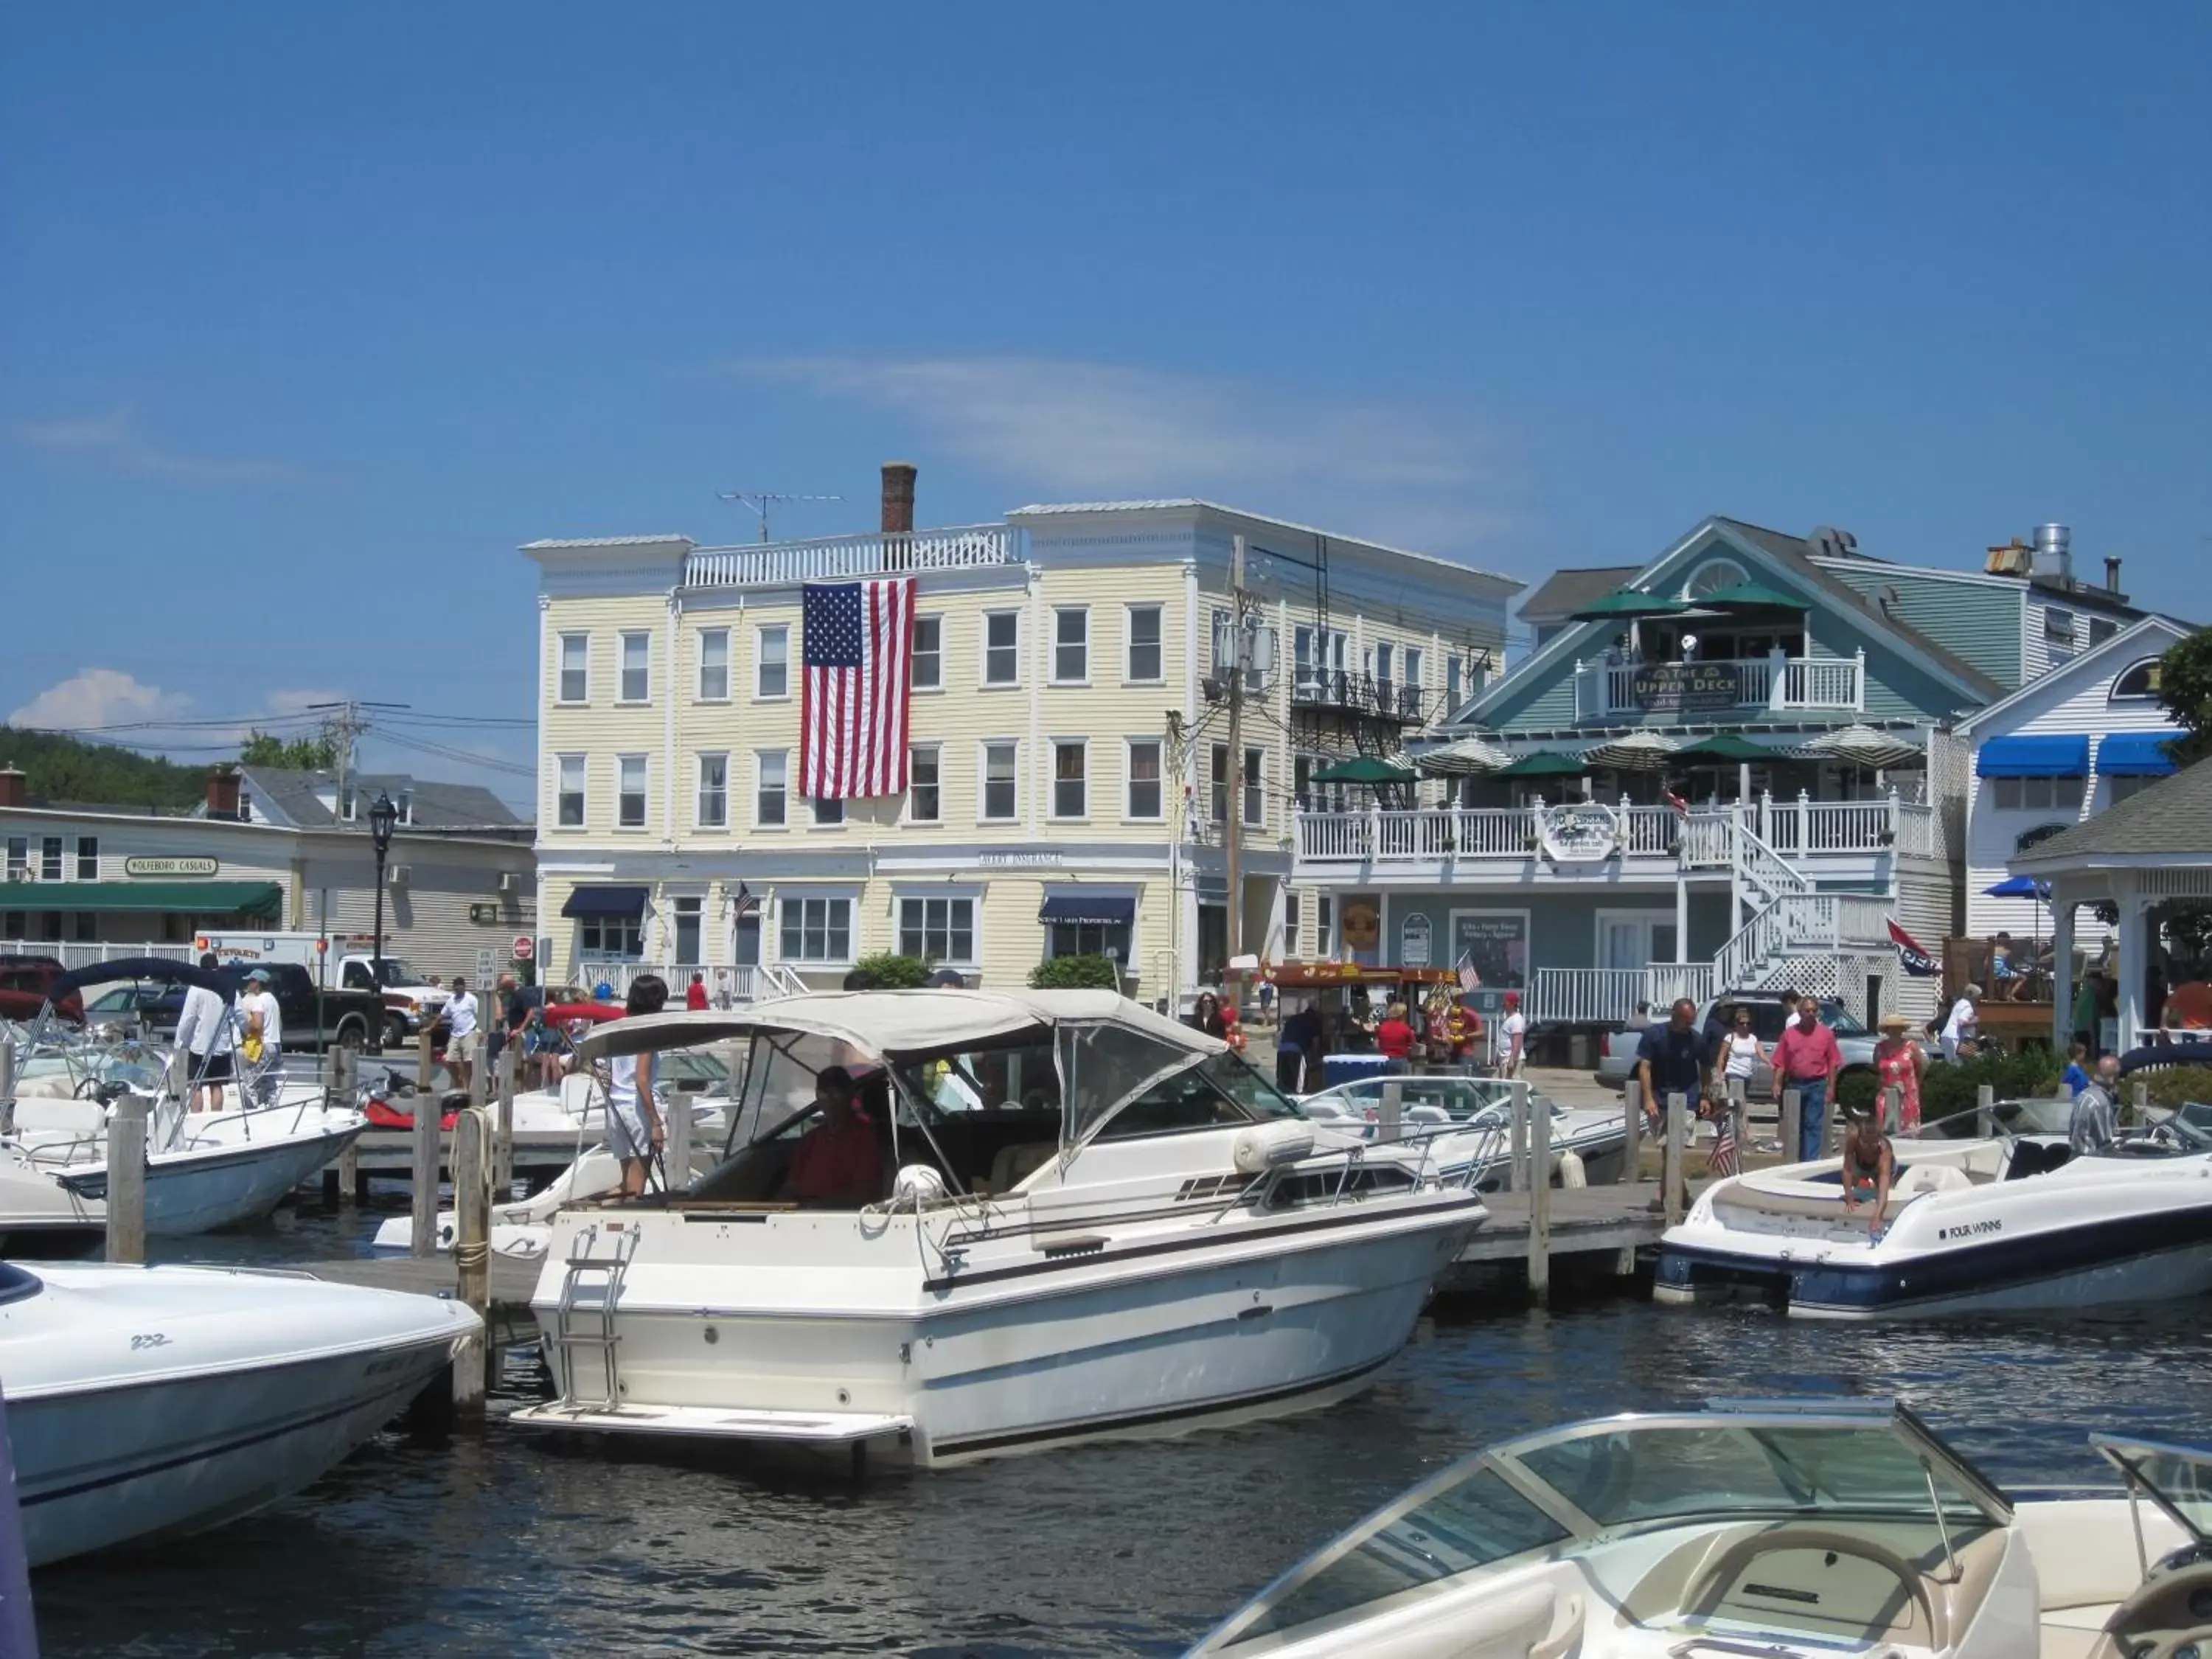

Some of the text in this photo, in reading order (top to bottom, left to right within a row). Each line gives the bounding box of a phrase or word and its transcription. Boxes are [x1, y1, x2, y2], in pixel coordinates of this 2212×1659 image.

[1672, 669, 1696, 679] THE
[1636, 678, 1736, 694] UPPER DECK
[131, 860, 212, 871] WOLFEBORO CASUALS
[1950, 1220, 2002, 1239] FOUR WINNS
[131, 1333, 173, 1350] 232
